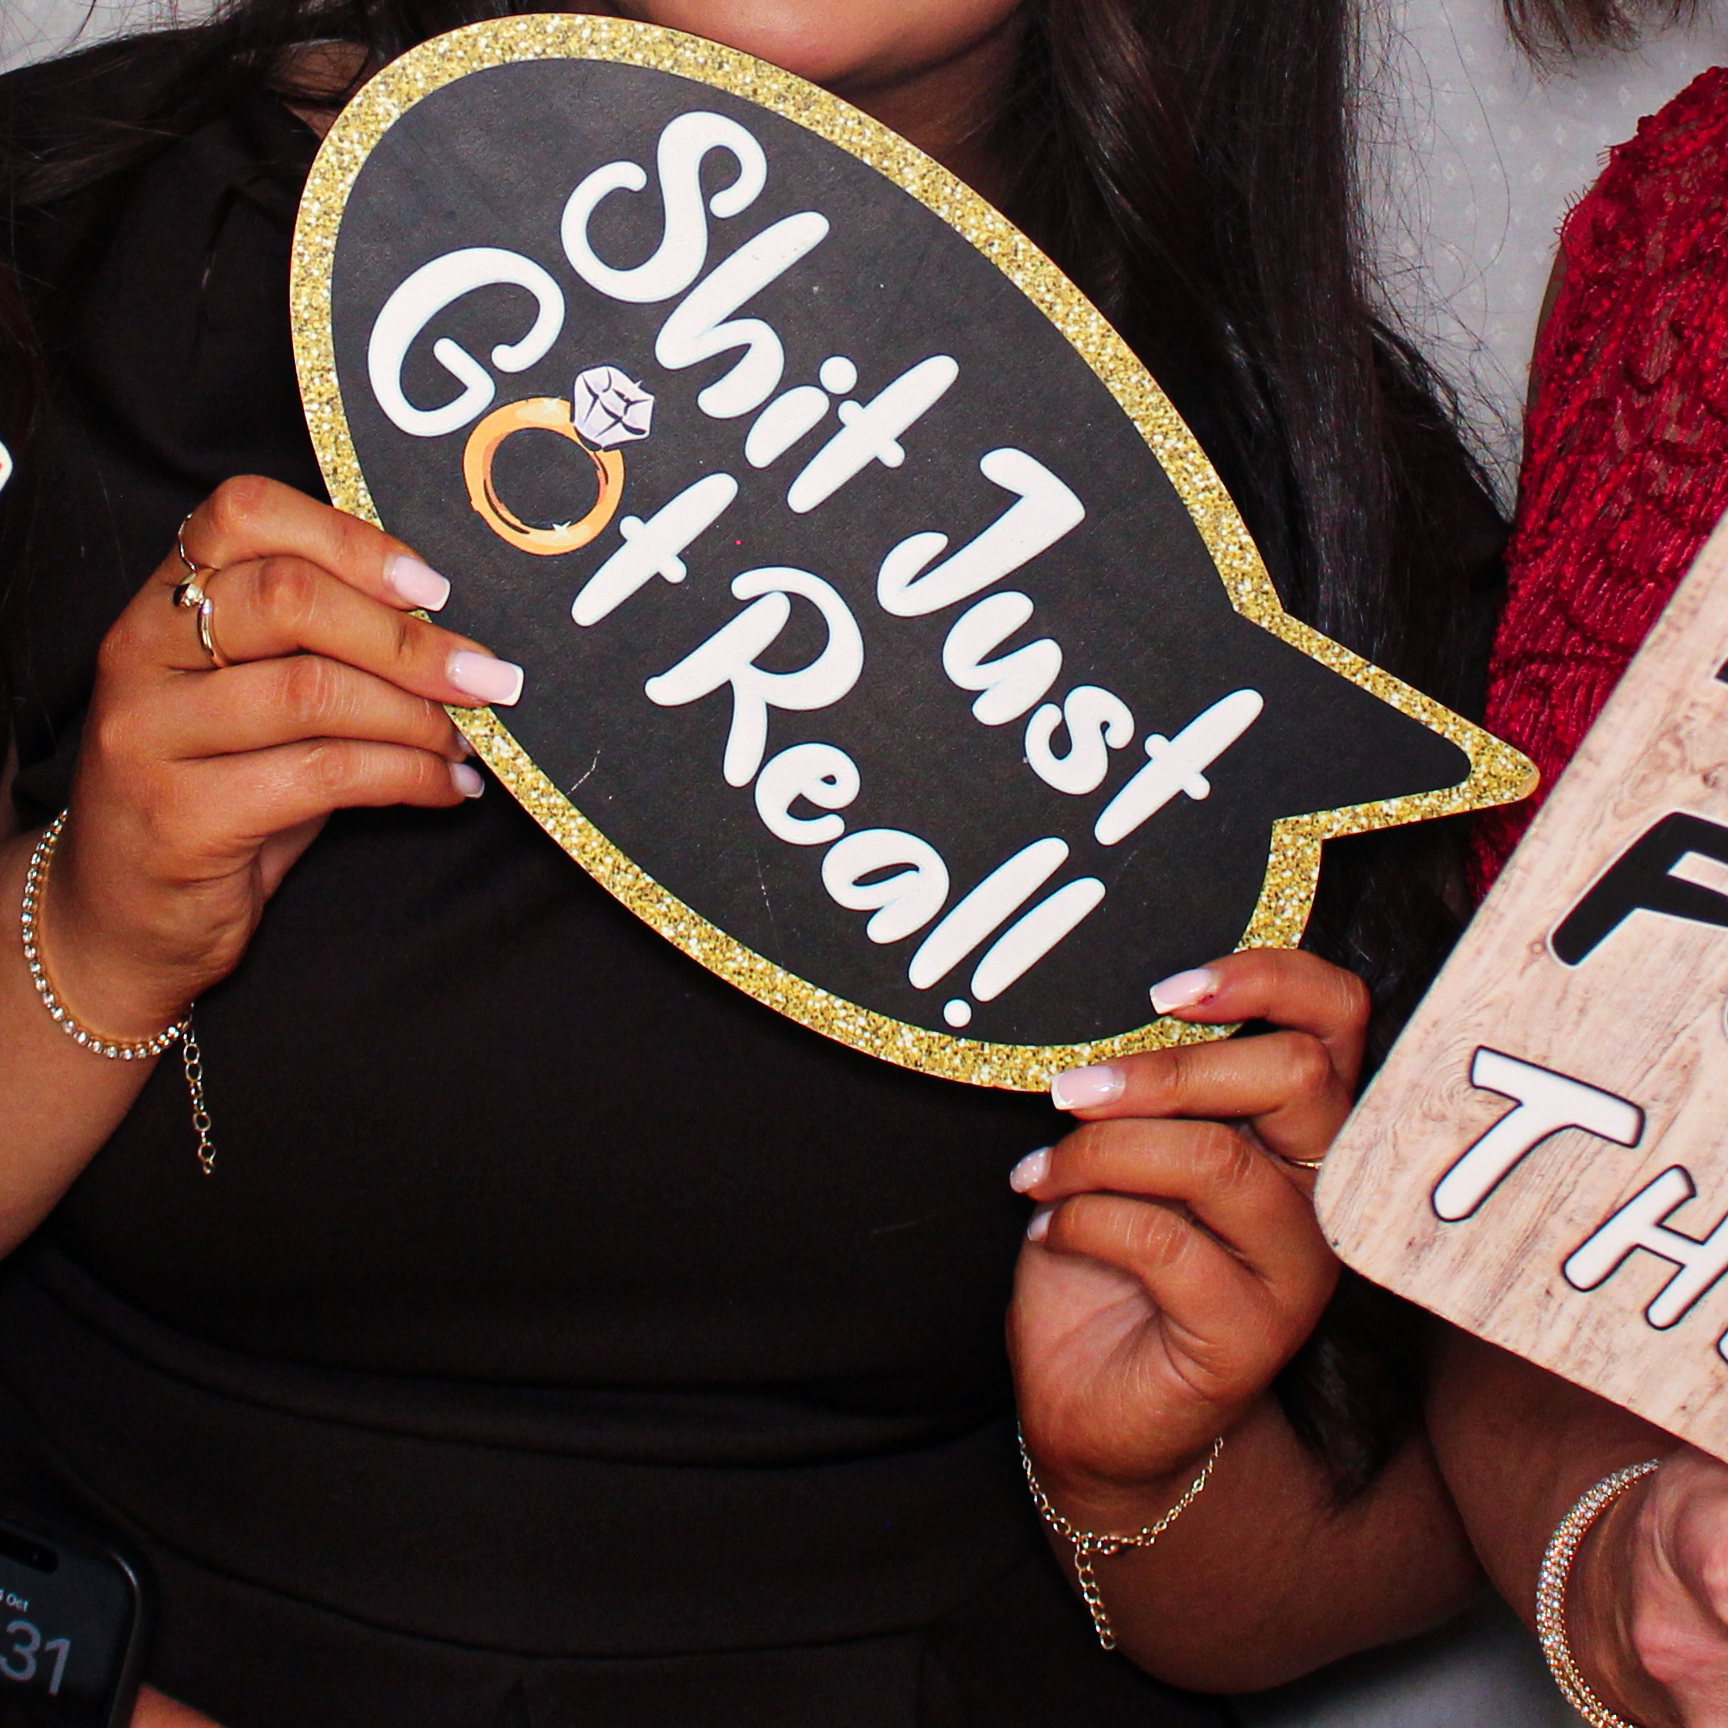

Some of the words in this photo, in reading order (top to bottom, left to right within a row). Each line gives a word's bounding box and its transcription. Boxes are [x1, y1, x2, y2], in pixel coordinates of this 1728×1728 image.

[561, 110, 960, 513] Shit
[876, 447, 1264, 846] Just
[645, 566, 1107, 1028] Real!
[6, 1592, 29, 1612] Oct
